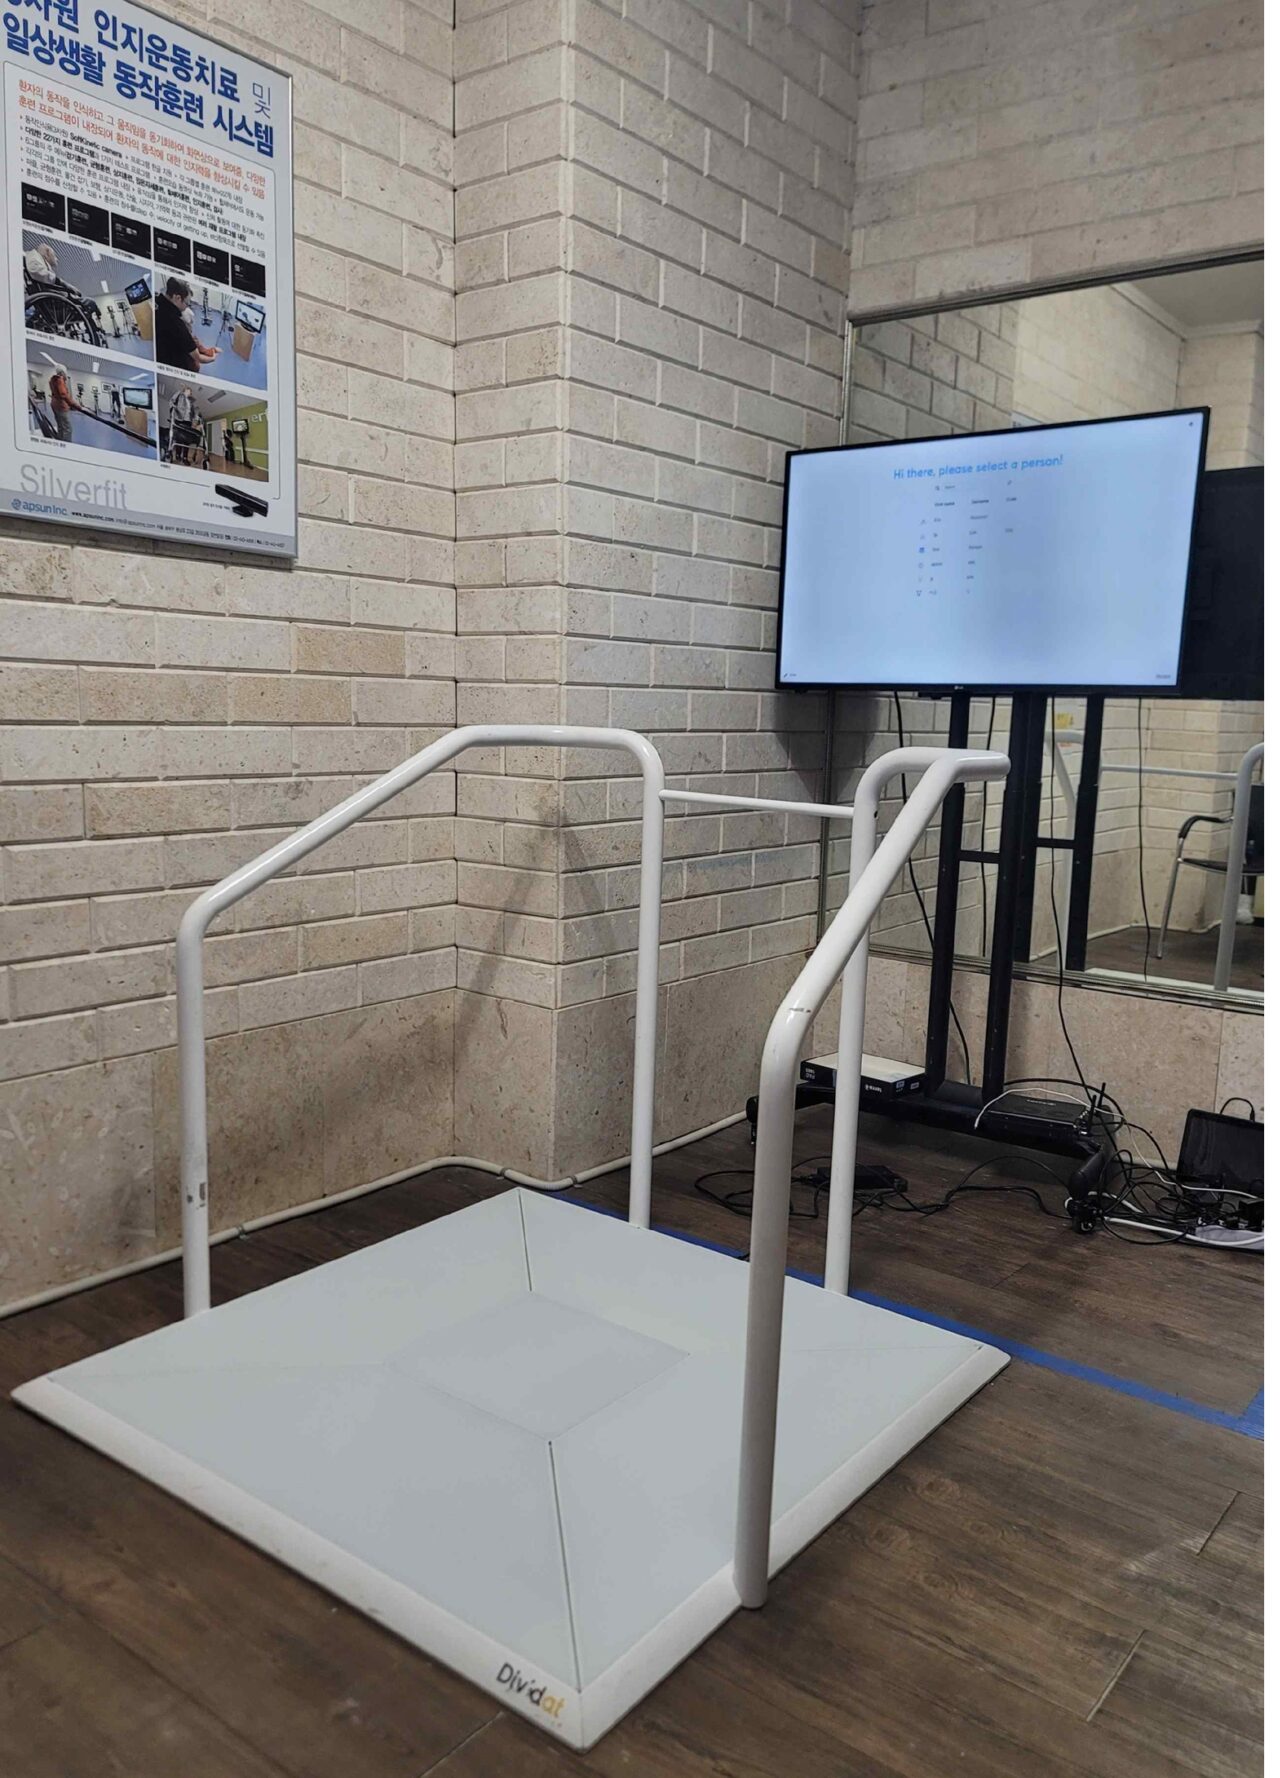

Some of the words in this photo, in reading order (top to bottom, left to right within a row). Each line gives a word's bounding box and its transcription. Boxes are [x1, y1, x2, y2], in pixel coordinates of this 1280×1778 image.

[94, 9, 240, 103] 인지운동치료
[3, 12, 106, 87] 일상생활
[113, 60, 204, 128] 동작훈련
[213, 105, 274, 158] 시스템
[106, 113, 114, 127] 그
[20, 464, 127, 509] Silverfit
[894, 469, 904, 480] Hi
[907, 468, 936, 479] there,
[939, 465, 973, 477] please
[976, 461, 1008, 473] select
[1011, 462, 1018, 470] a
[1021, 454, 1063, 471] person!
